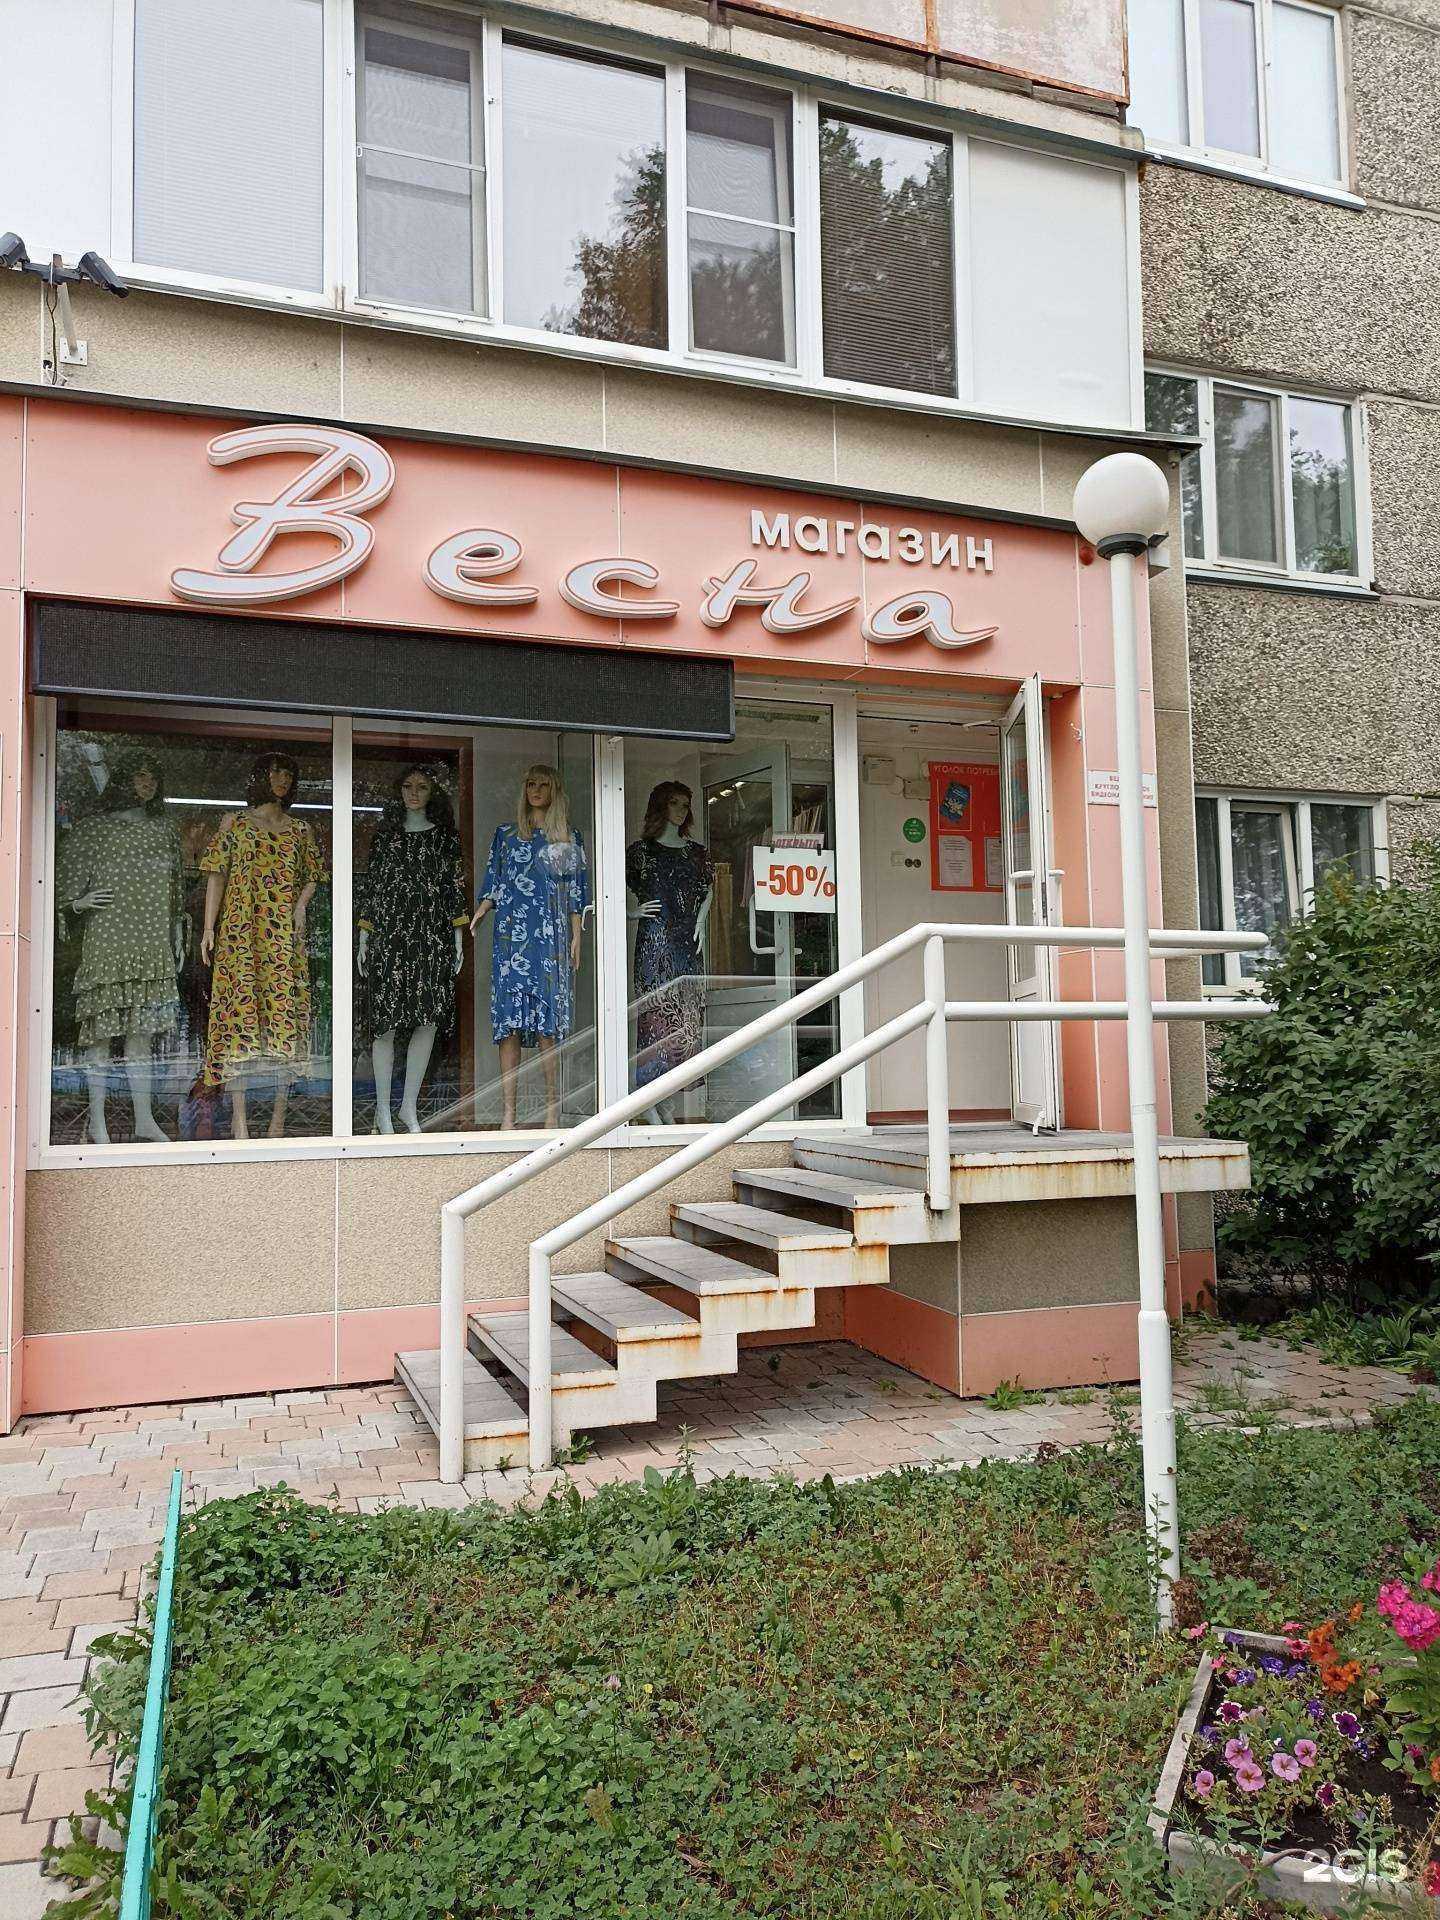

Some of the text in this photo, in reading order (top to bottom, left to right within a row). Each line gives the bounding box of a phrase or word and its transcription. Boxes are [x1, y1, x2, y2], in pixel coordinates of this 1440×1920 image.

[169, 424, 1000, 650] Весна
[751, 509, 994, 572] магазин
[756, 864, 836, 897] -50%
